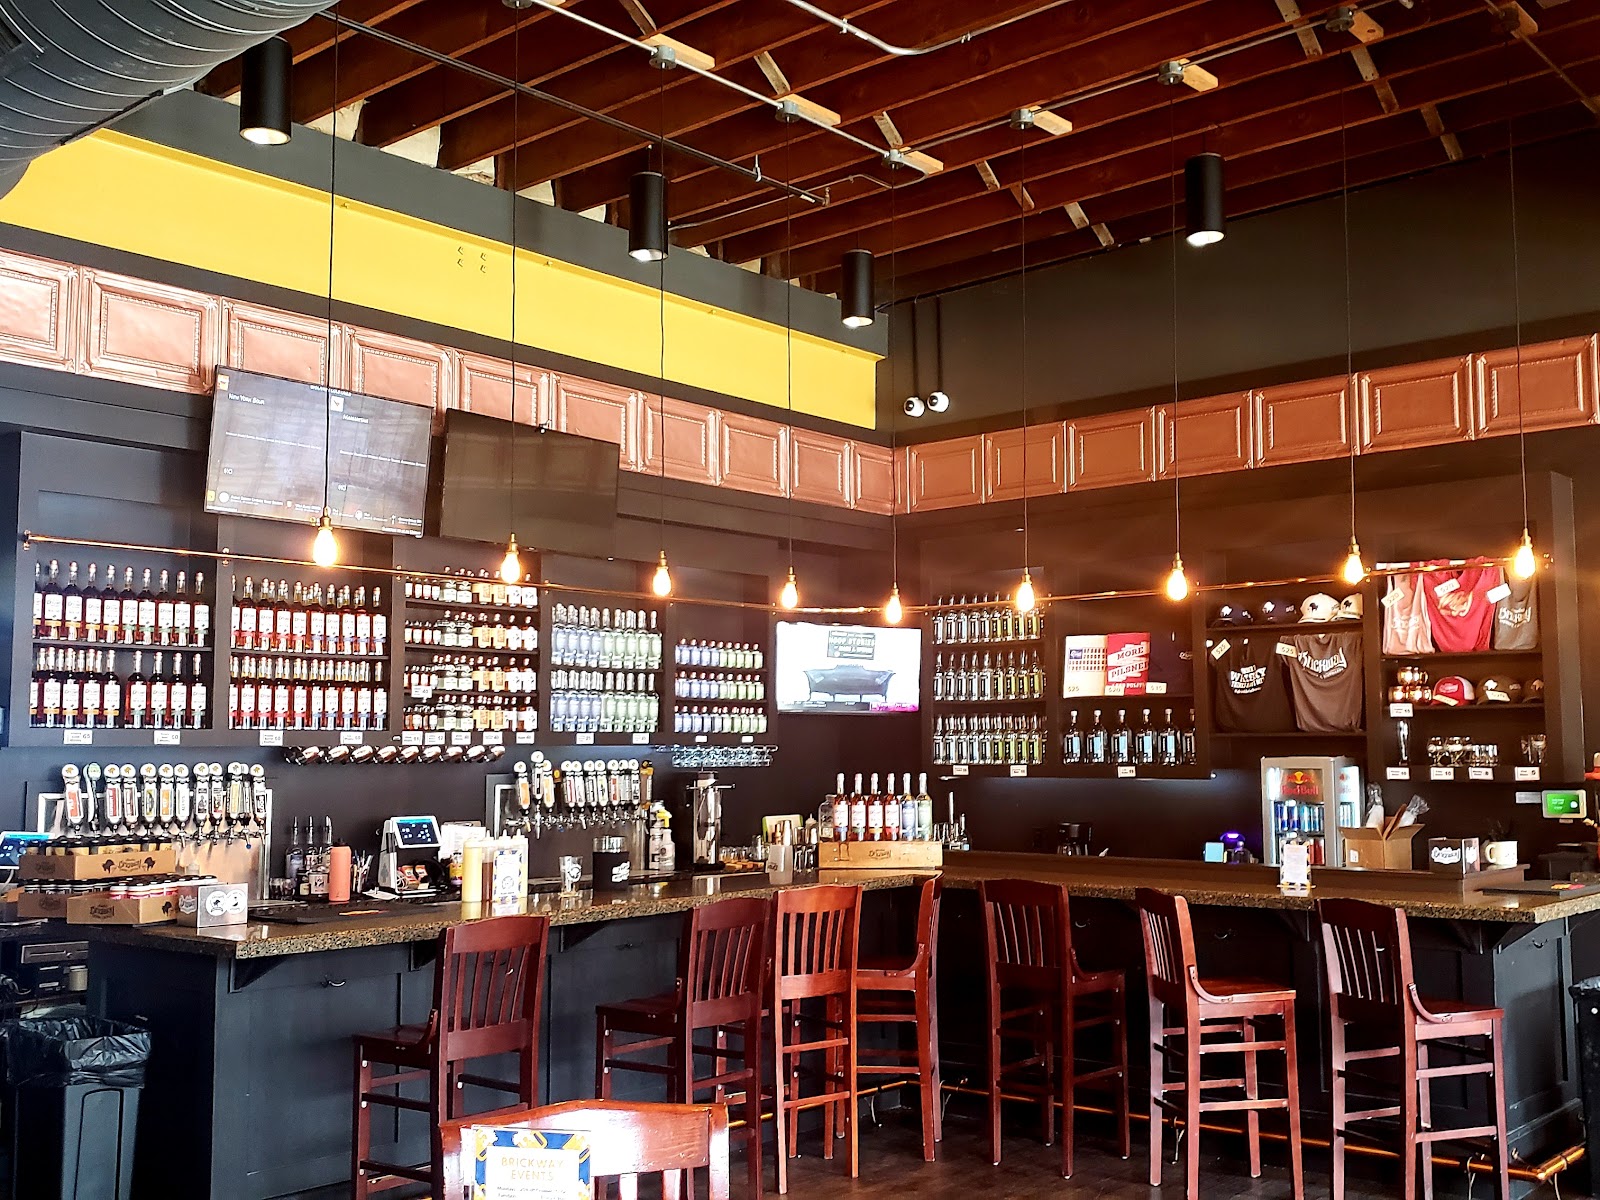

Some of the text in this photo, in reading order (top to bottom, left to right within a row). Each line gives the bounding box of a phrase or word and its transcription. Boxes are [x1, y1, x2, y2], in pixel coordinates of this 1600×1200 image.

[1117, 646, 1144, 660] MORE
[1282, 784, 1319, 795] Red Bull
[501, 1157, 564, 1168] BRICKWAY
[511, 1170, 554, 1181] EVENTS
